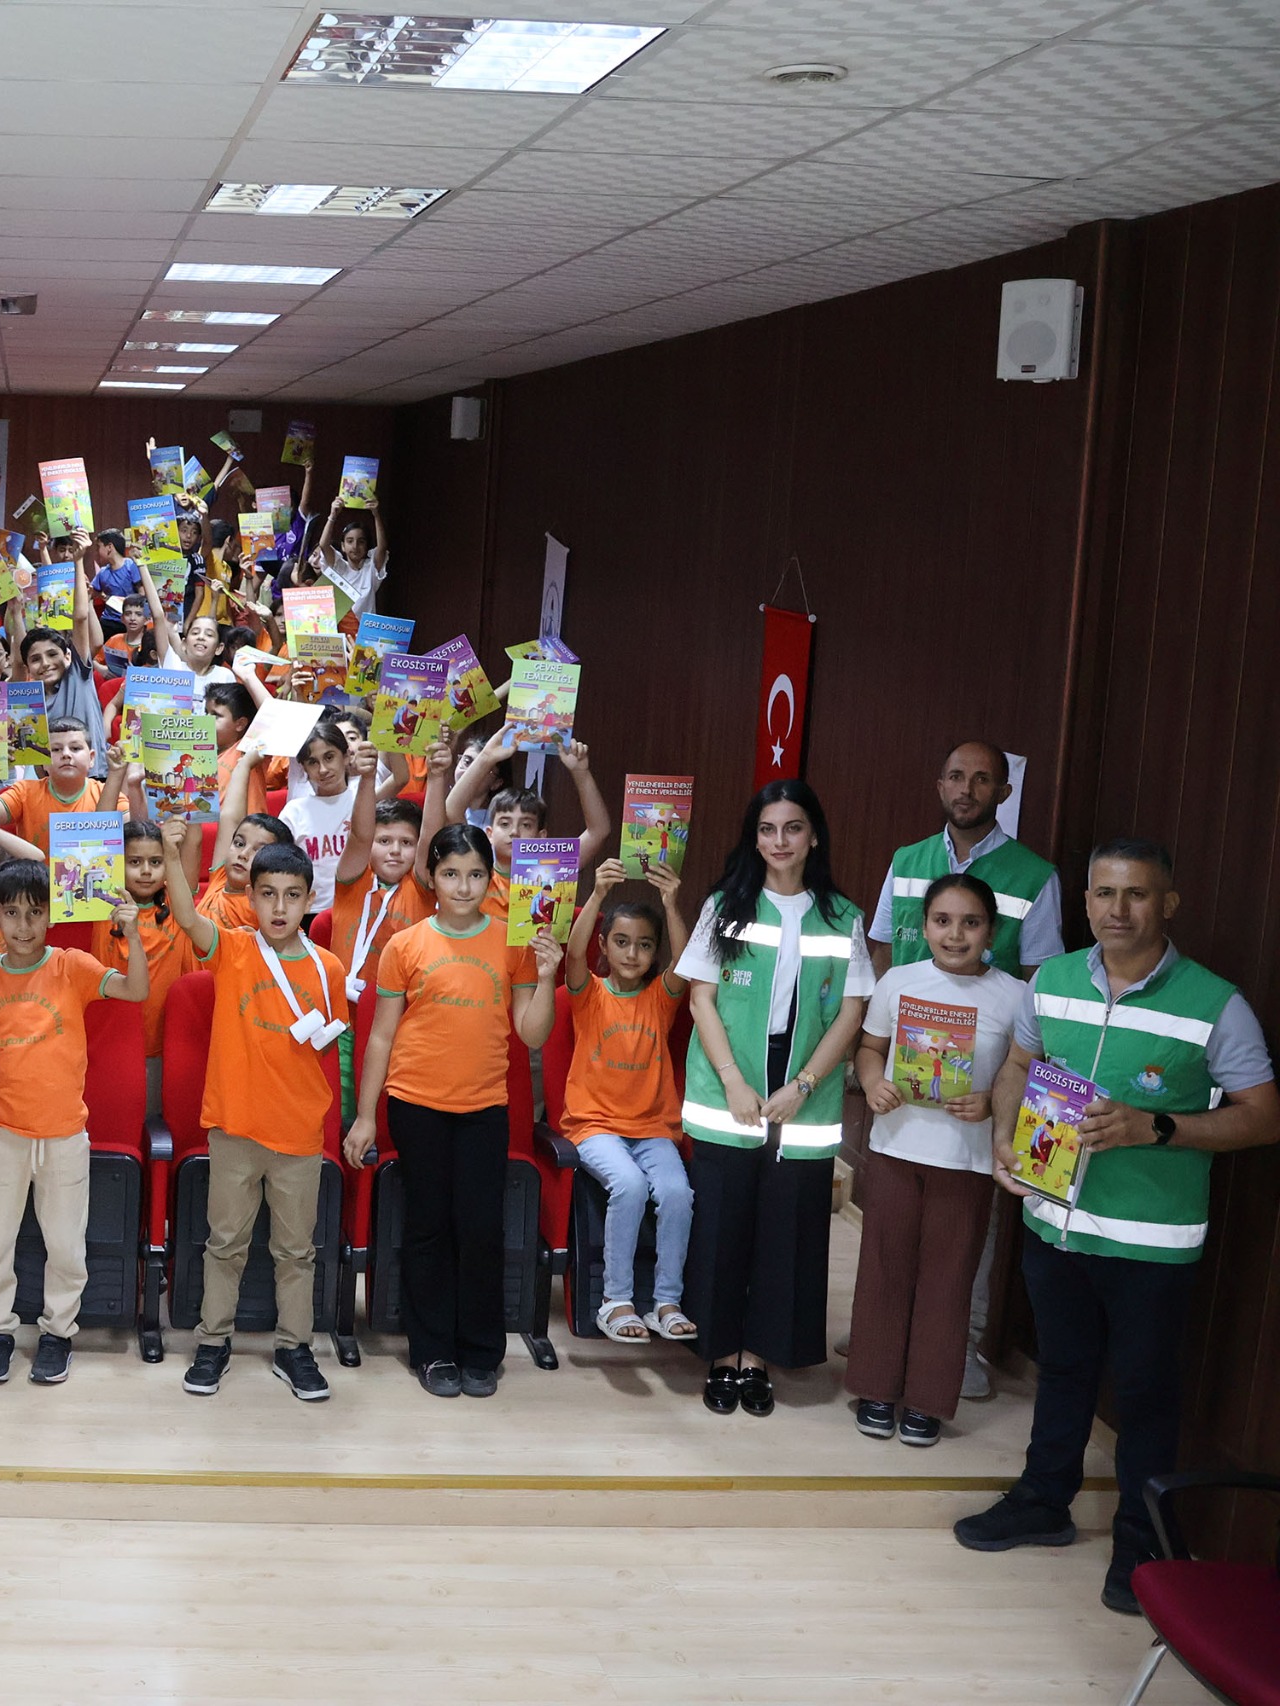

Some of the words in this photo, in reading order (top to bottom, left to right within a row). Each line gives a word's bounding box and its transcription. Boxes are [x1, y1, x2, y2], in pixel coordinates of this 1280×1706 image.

[390, 657, 444, 673] EKOSİSTEM
[534, 663, 563, 673] ÇEVRE
[160, 717, 194, 729] ÇEVRE
[520, 842, 574, 853] EKOSİSTEM
[732, 969, 752, 977] SIFIR
[732, 977, 751, 987] ATIK
[1034, 1065, 1088, 1095] EKOSİSTEM
